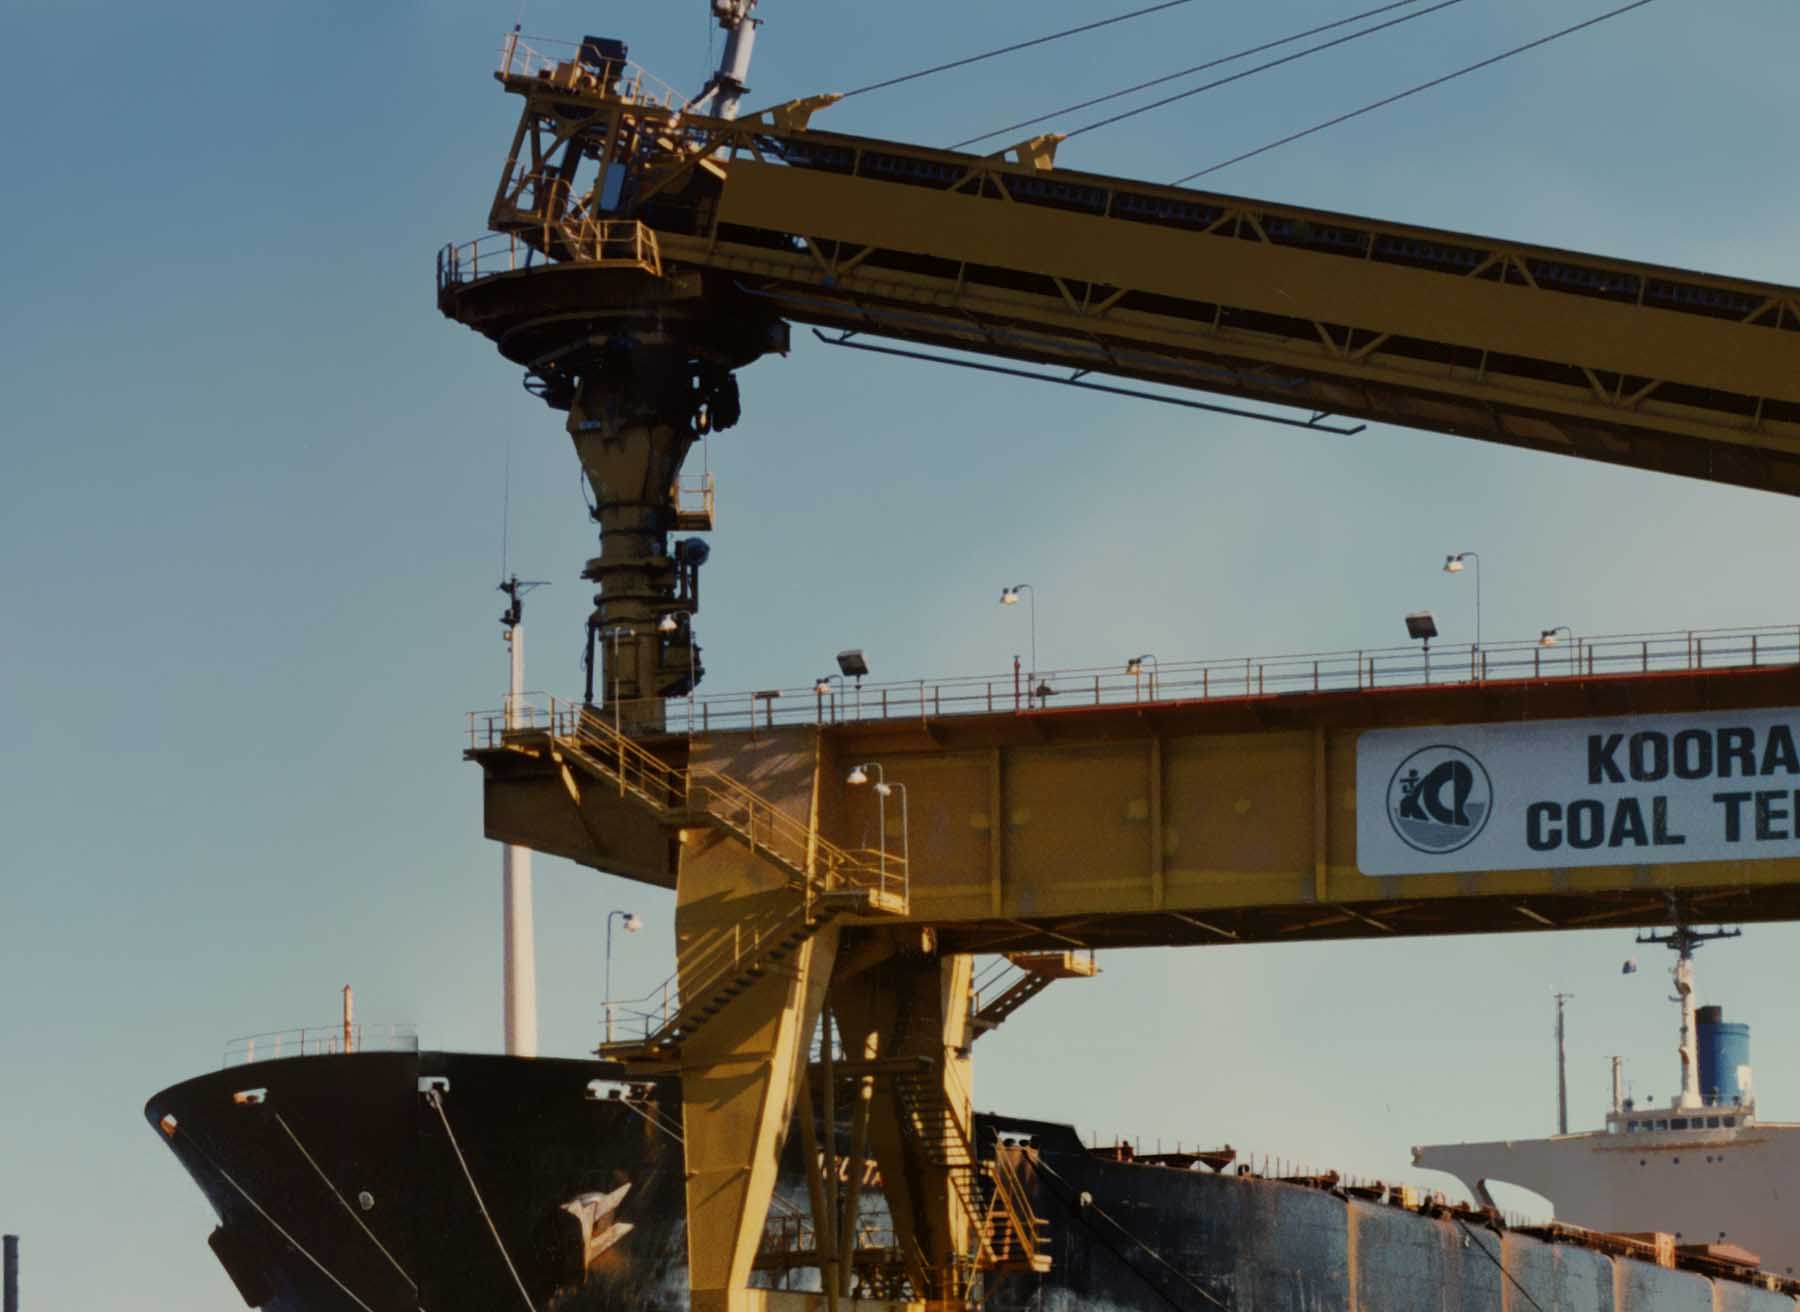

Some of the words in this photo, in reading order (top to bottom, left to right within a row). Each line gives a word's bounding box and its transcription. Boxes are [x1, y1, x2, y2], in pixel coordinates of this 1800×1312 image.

[1587, 724, 1800, 784] KOORA
[1526, 796, 1686, 851] COAL
[1713, 789, 1800, 842] TE
